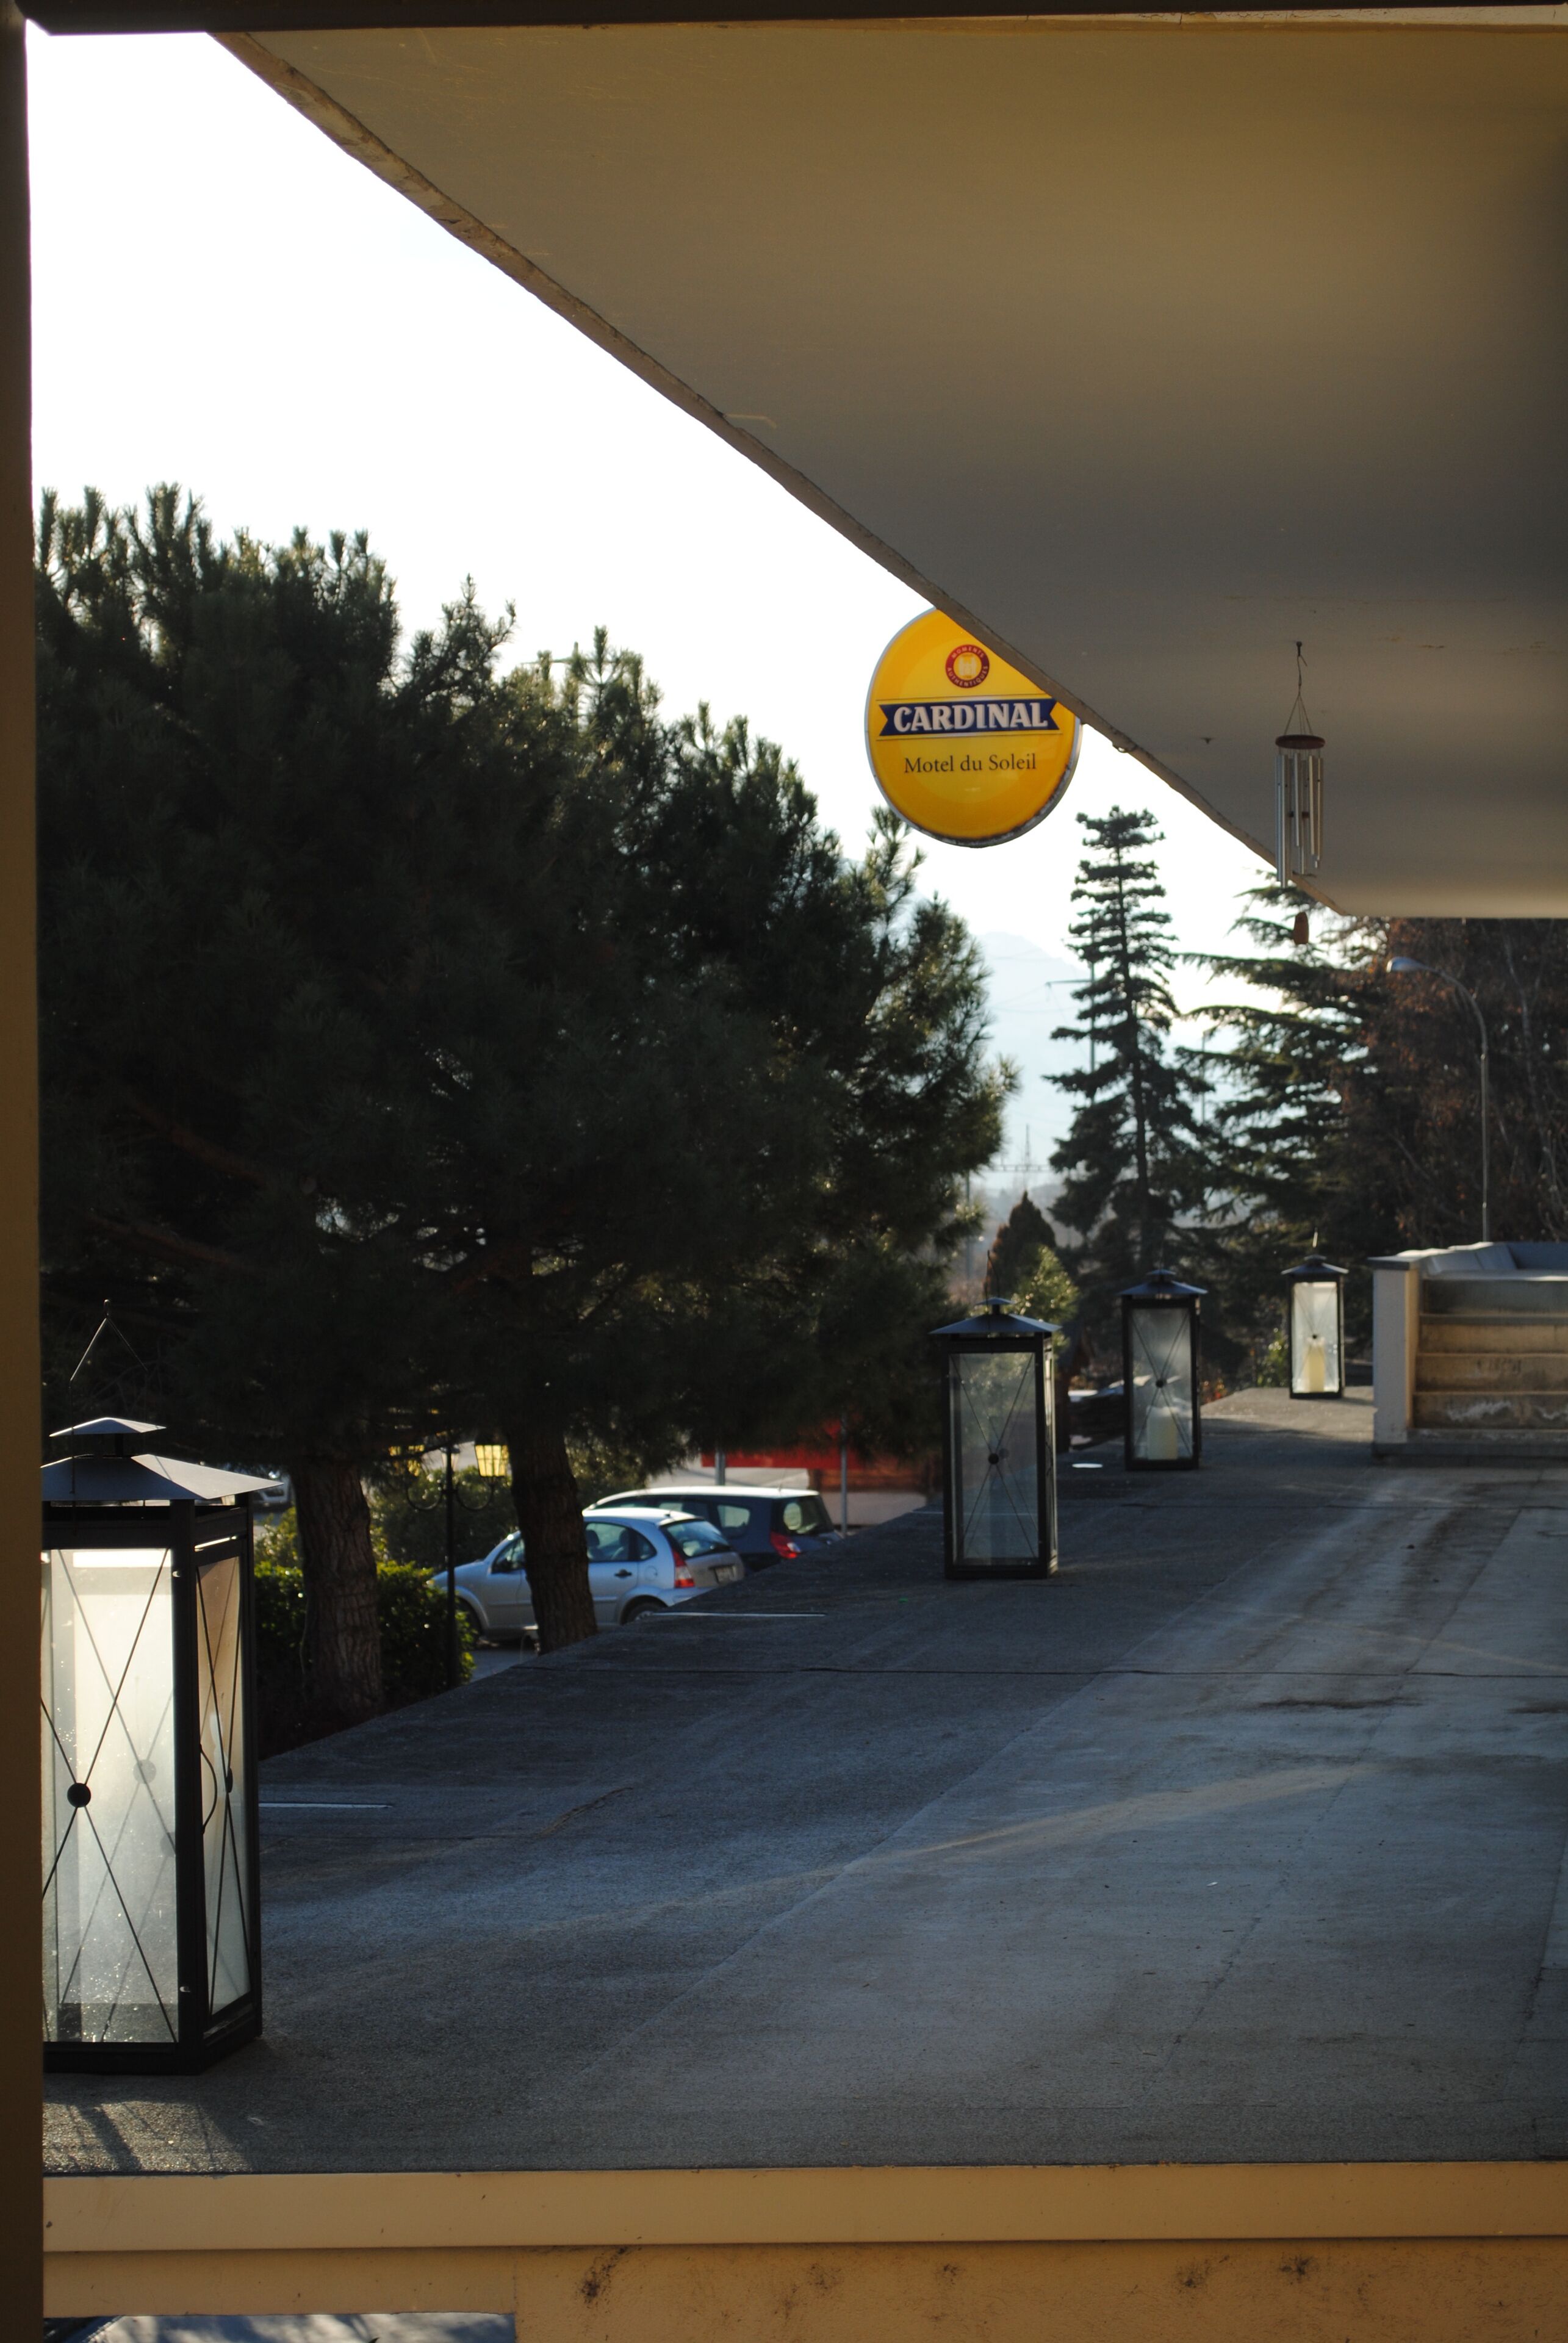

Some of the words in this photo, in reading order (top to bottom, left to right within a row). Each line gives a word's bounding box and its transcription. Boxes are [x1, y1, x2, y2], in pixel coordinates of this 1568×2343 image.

[951, 646, 985, 659] MOMENTS
[947, 666, 988, 687] AUTHENTIQUES
[893, 702, 1048, 733] CARDINAL
[904, 755, 954, 773] Motel
[960, 754, 983, 771] du
[988, 753, 1037, 770] Soleil
